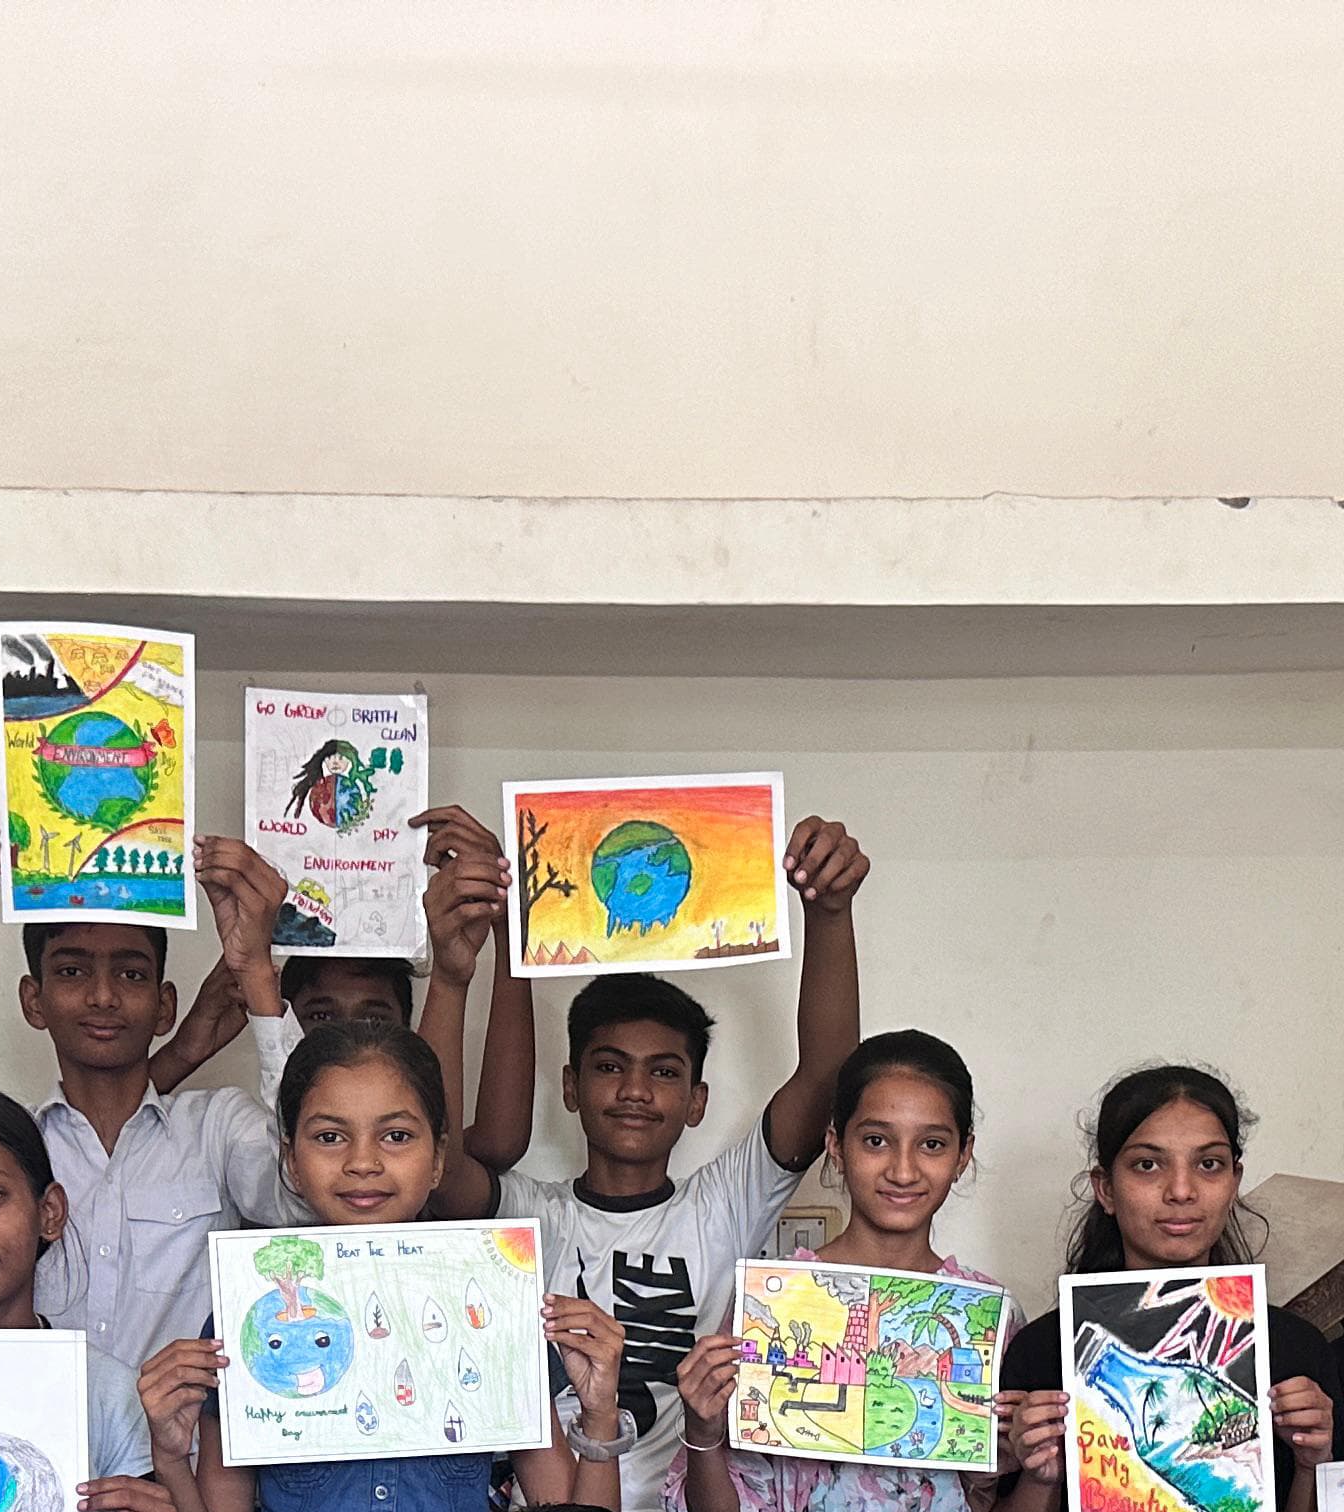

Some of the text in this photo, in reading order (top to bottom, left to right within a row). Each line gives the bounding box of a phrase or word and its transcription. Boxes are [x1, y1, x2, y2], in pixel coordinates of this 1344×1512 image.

[6, 730, 34, 749] World
[259, 819, 399, 843] WORLD DAY
[245, 1404, 287, 1424] Happy
[1077, 1420, 1130, 1463] Save
[1100, 1454, 1130, 1489] My
